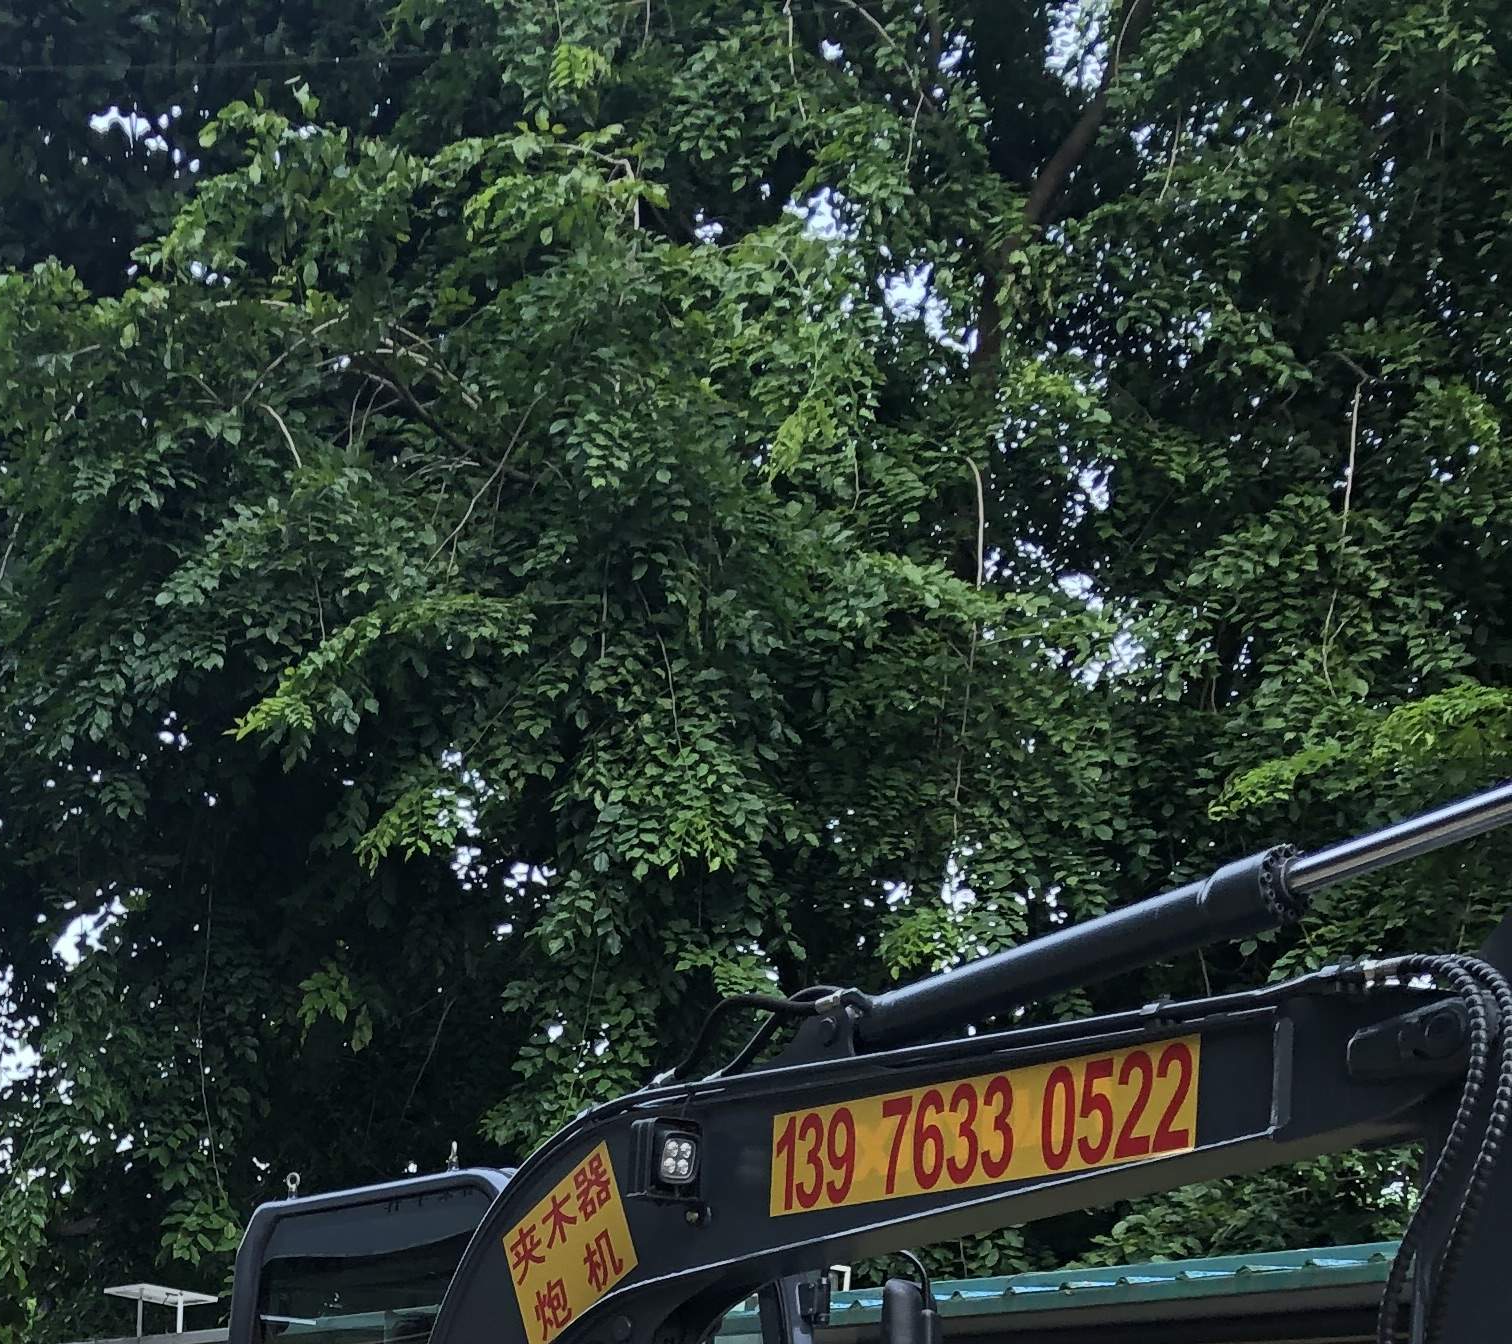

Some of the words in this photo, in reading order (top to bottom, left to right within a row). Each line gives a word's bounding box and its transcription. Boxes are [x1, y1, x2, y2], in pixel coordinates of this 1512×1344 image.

[776, 1107, 855, 1210] 139
[882, 1075, 1013, 1194] 7633
[1041, 1043, 1193, 1170] 0522
[510, 1153, 611, 1286] 夹木器
[534, 1228, 623, 1341] 炮机
